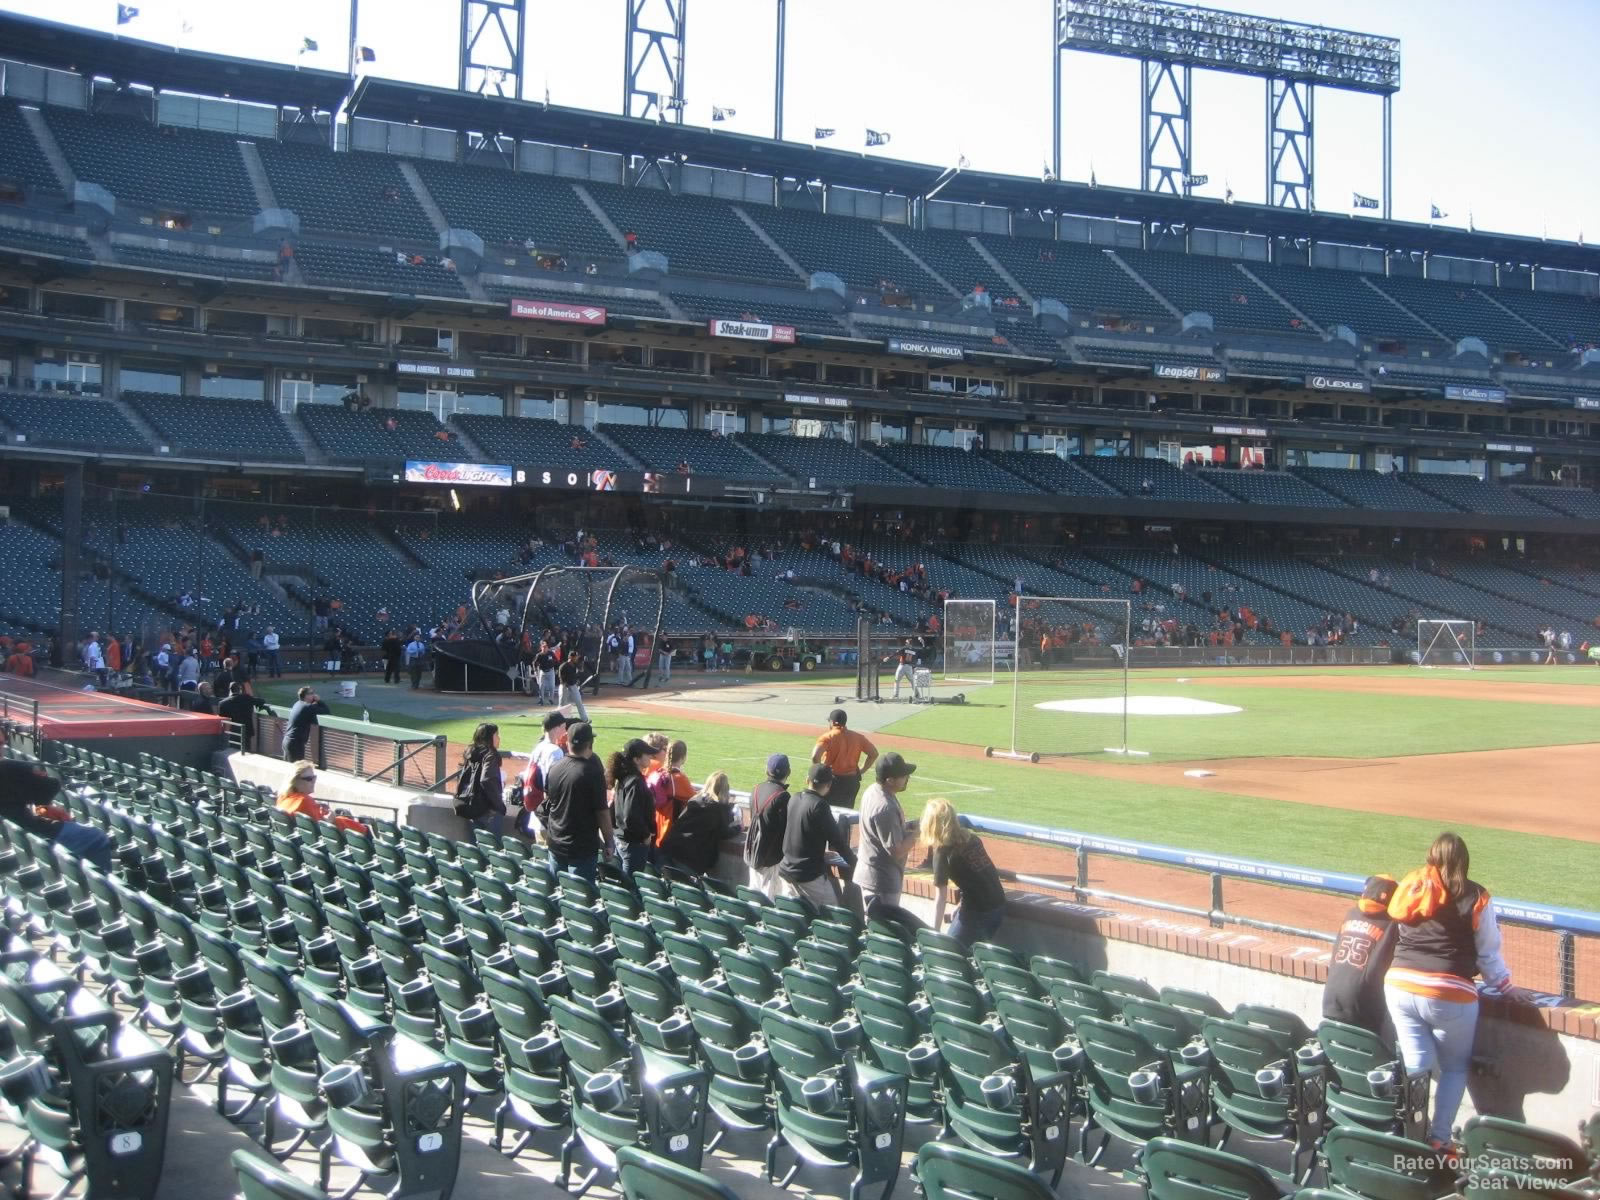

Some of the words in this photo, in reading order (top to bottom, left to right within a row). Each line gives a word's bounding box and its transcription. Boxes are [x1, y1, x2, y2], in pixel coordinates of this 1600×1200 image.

[517, 305, 537, 315] Bank
[538, 307, 547, 316] of
[547, 307, 581, 319] America
[720, 322, 769, 338] Steak-umm
[900, 343, 930, 353] KONICA
[930, 345, 962, 356] MINOLTA
[416, 364, 441, 375] AMERICA
[461, 368, 475, 377] LEVEL
[1159, 365, 1199, 378] Leapset
[1205, 372, 1221, 380] APP
[1326, 379, 1363, 390] LEXUS
[424, 464, 462, 481] Coors
[459, 471, 497, 482] LIGHT
[516, 470, 526, 483] B
[542, 472, 551, 484] S
[1502, 906, 1524, 918] YOUR
[1335, 935, 1371, 970] 55
[122, 1135, 131, 1149] 8
[427, 1136, 434, 1148] 7
[676, 1135, 683, 1147] 6
[881, 1135, 887, 1145] 5
